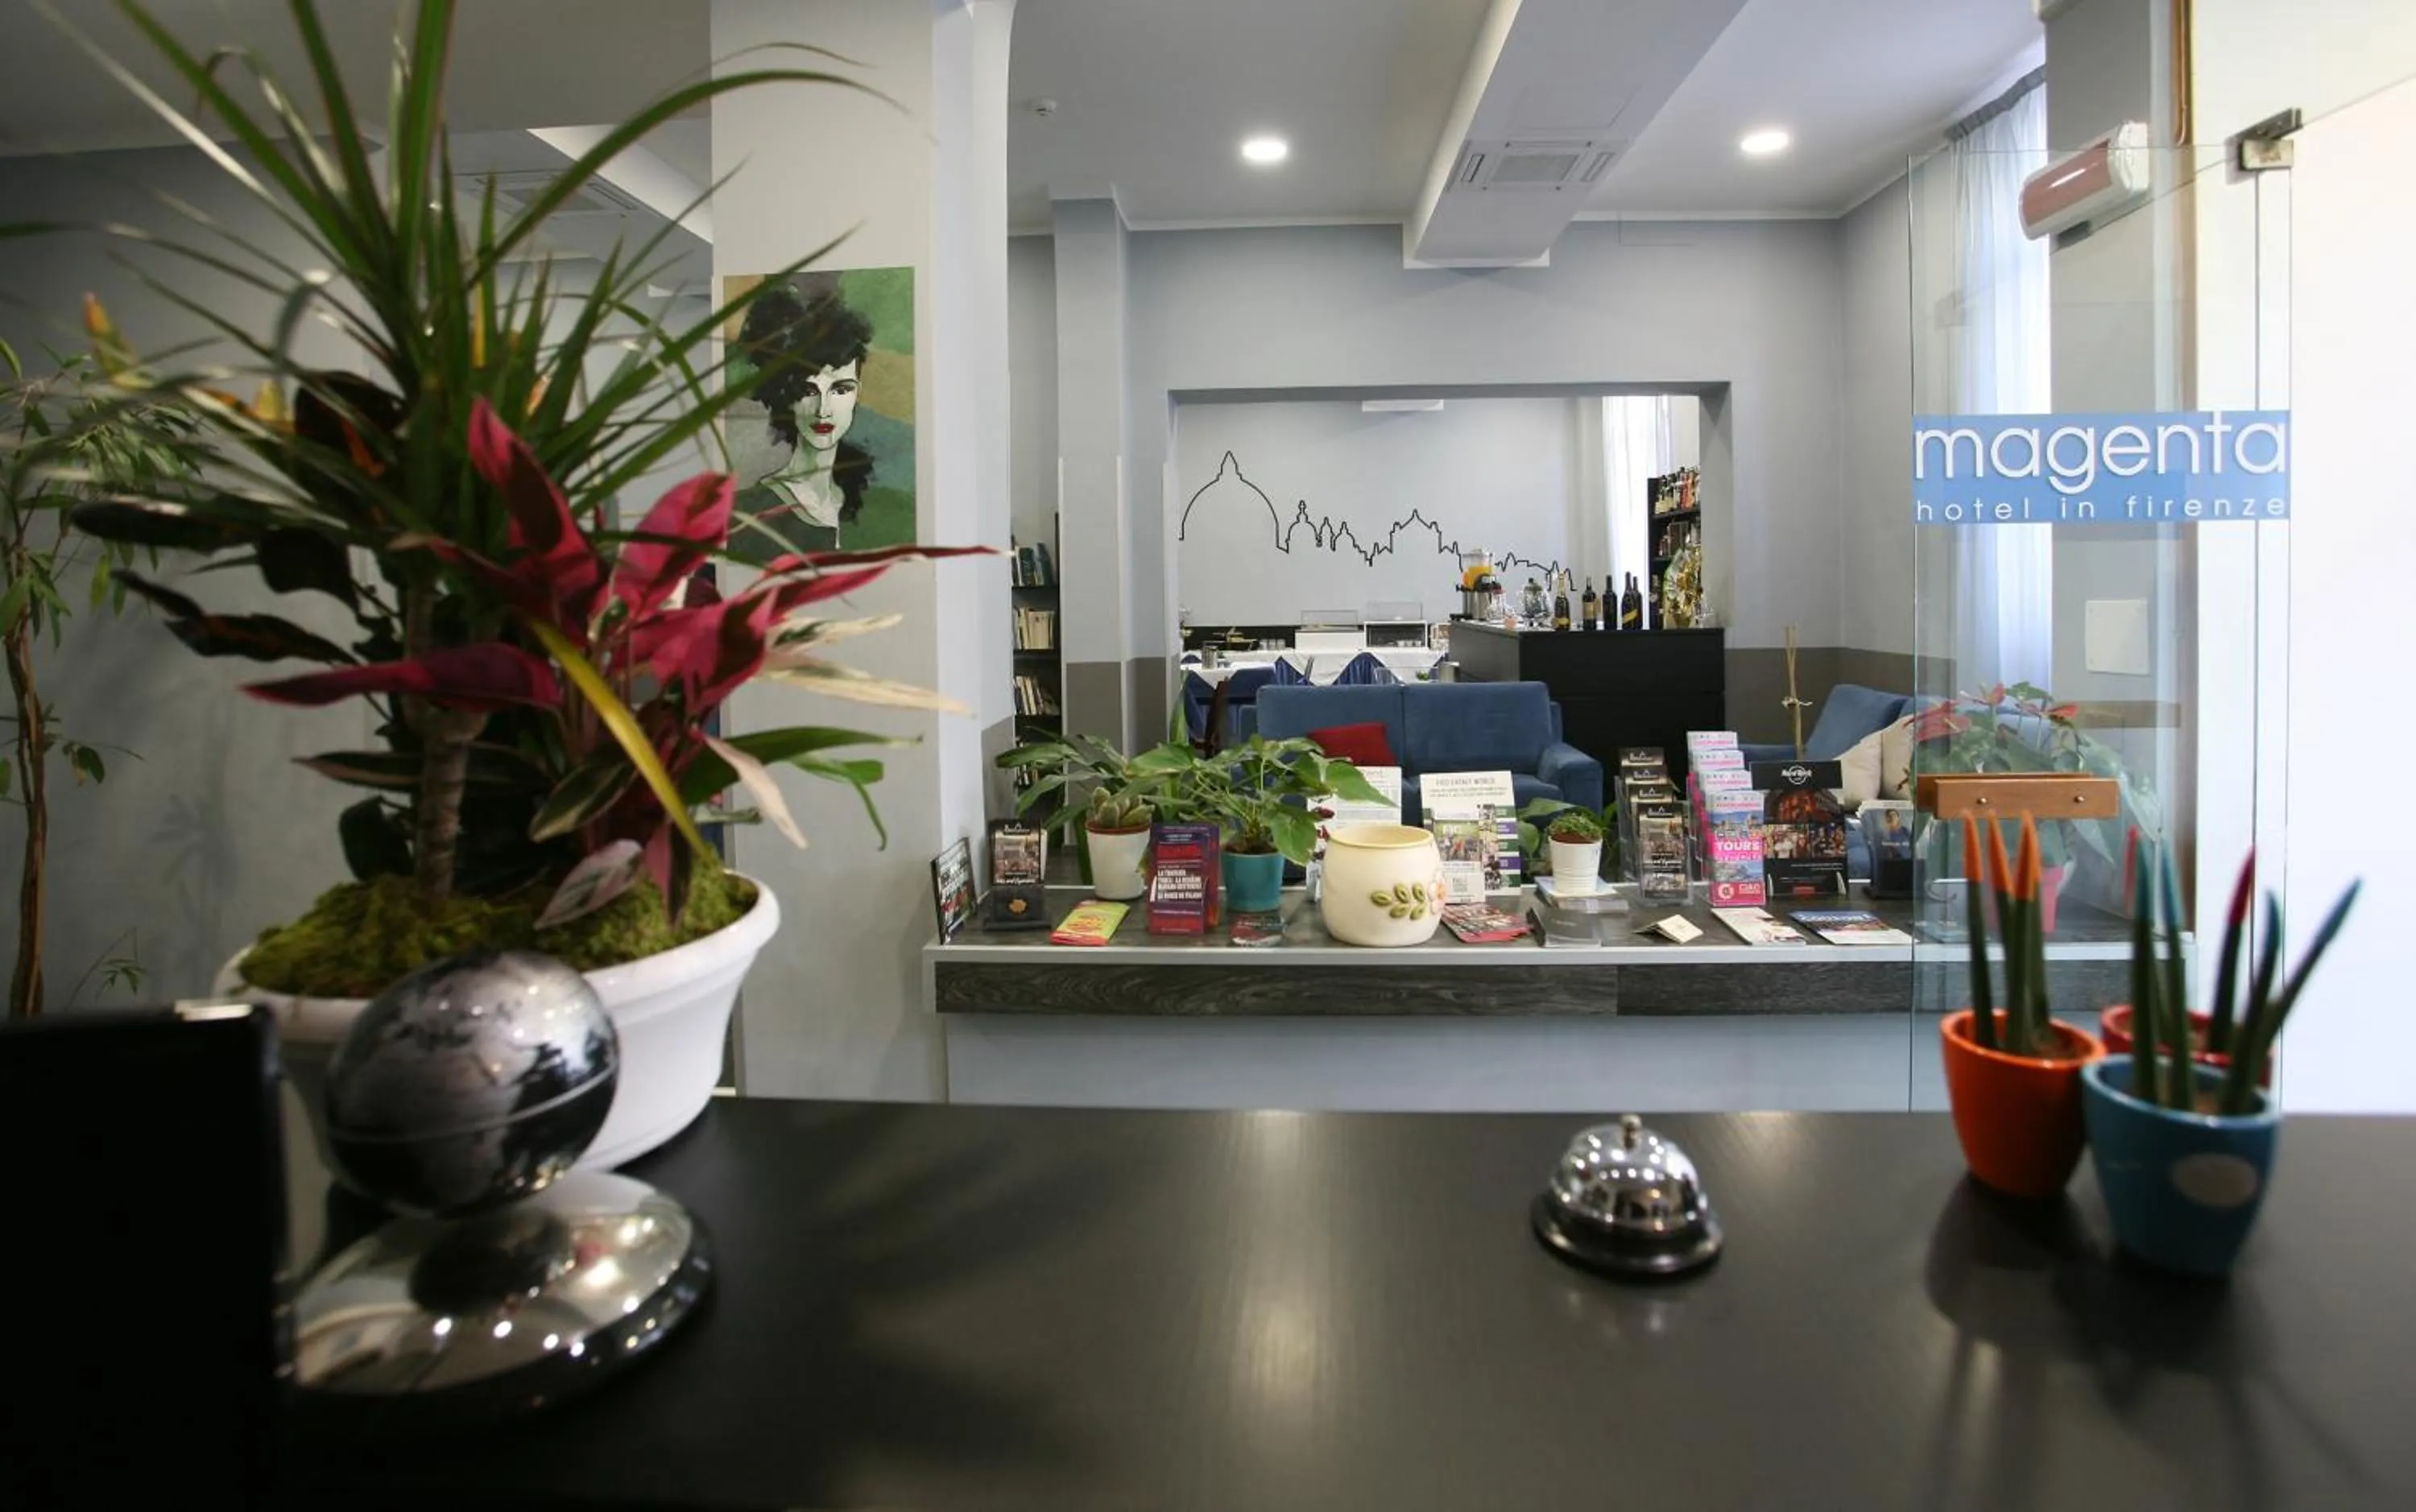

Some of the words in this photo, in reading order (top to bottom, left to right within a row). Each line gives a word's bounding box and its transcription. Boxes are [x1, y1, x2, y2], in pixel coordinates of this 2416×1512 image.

[1915, 411, 2285, 494] magenta
[1917, 498, 2029, 521] hotel
[2061, 496, 2095, 519] in
[2126, 495, 2285, 517] firenze
[1717, 841, 1760, 851] TOURS
